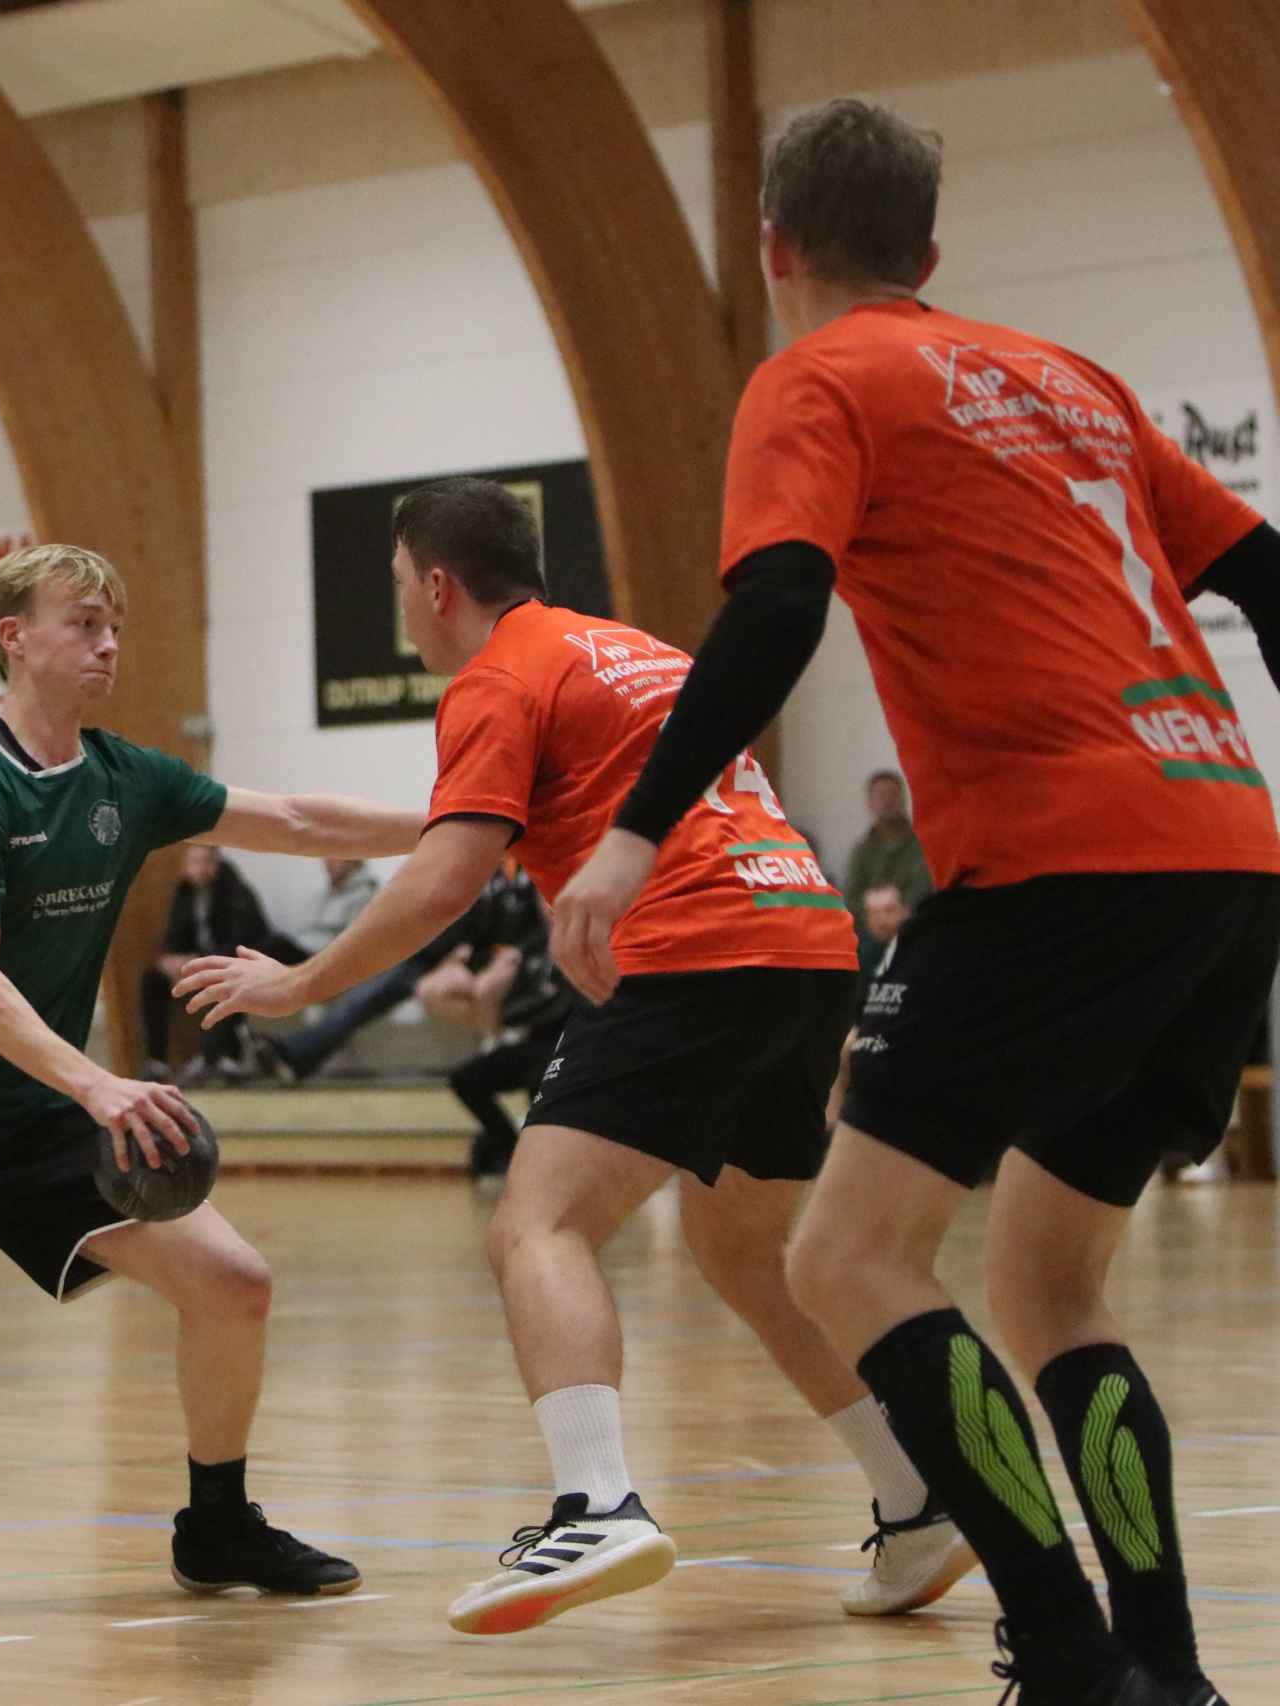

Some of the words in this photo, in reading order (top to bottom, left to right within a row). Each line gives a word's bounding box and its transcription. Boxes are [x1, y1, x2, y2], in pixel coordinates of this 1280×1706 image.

[959, 367, 1007, 398] HP
[1065, 477, 1173, 648] 7
[599, 645, 631, 662] HP
